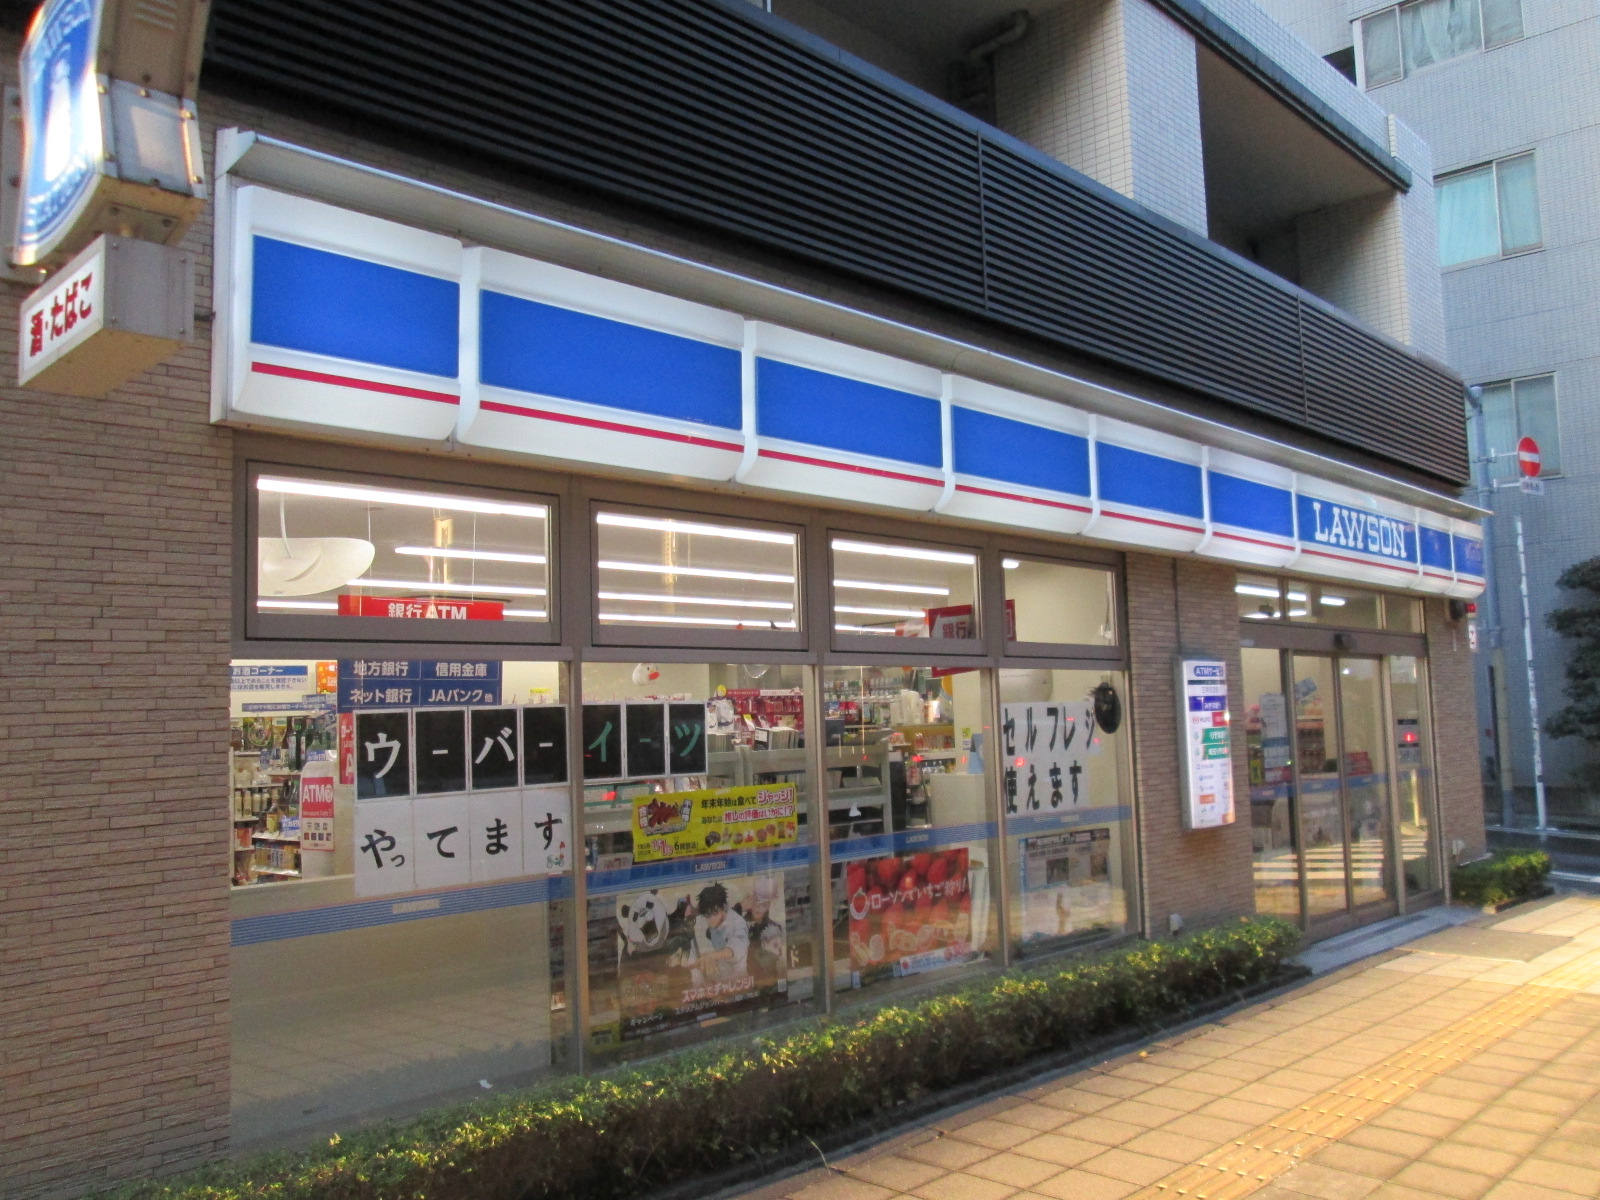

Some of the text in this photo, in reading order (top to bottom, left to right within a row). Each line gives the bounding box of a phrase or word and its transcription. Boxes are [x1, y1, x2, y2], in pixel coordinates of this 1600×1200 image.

[1313, 502, 1407, 558] LAWSON
[354, 661, 408, 677] 地方銀行
[436, 662, 487, 677] 信用金庫
[351, 688, 412, 703] ネット銀行
[360, 813, 562, 869] やってます
